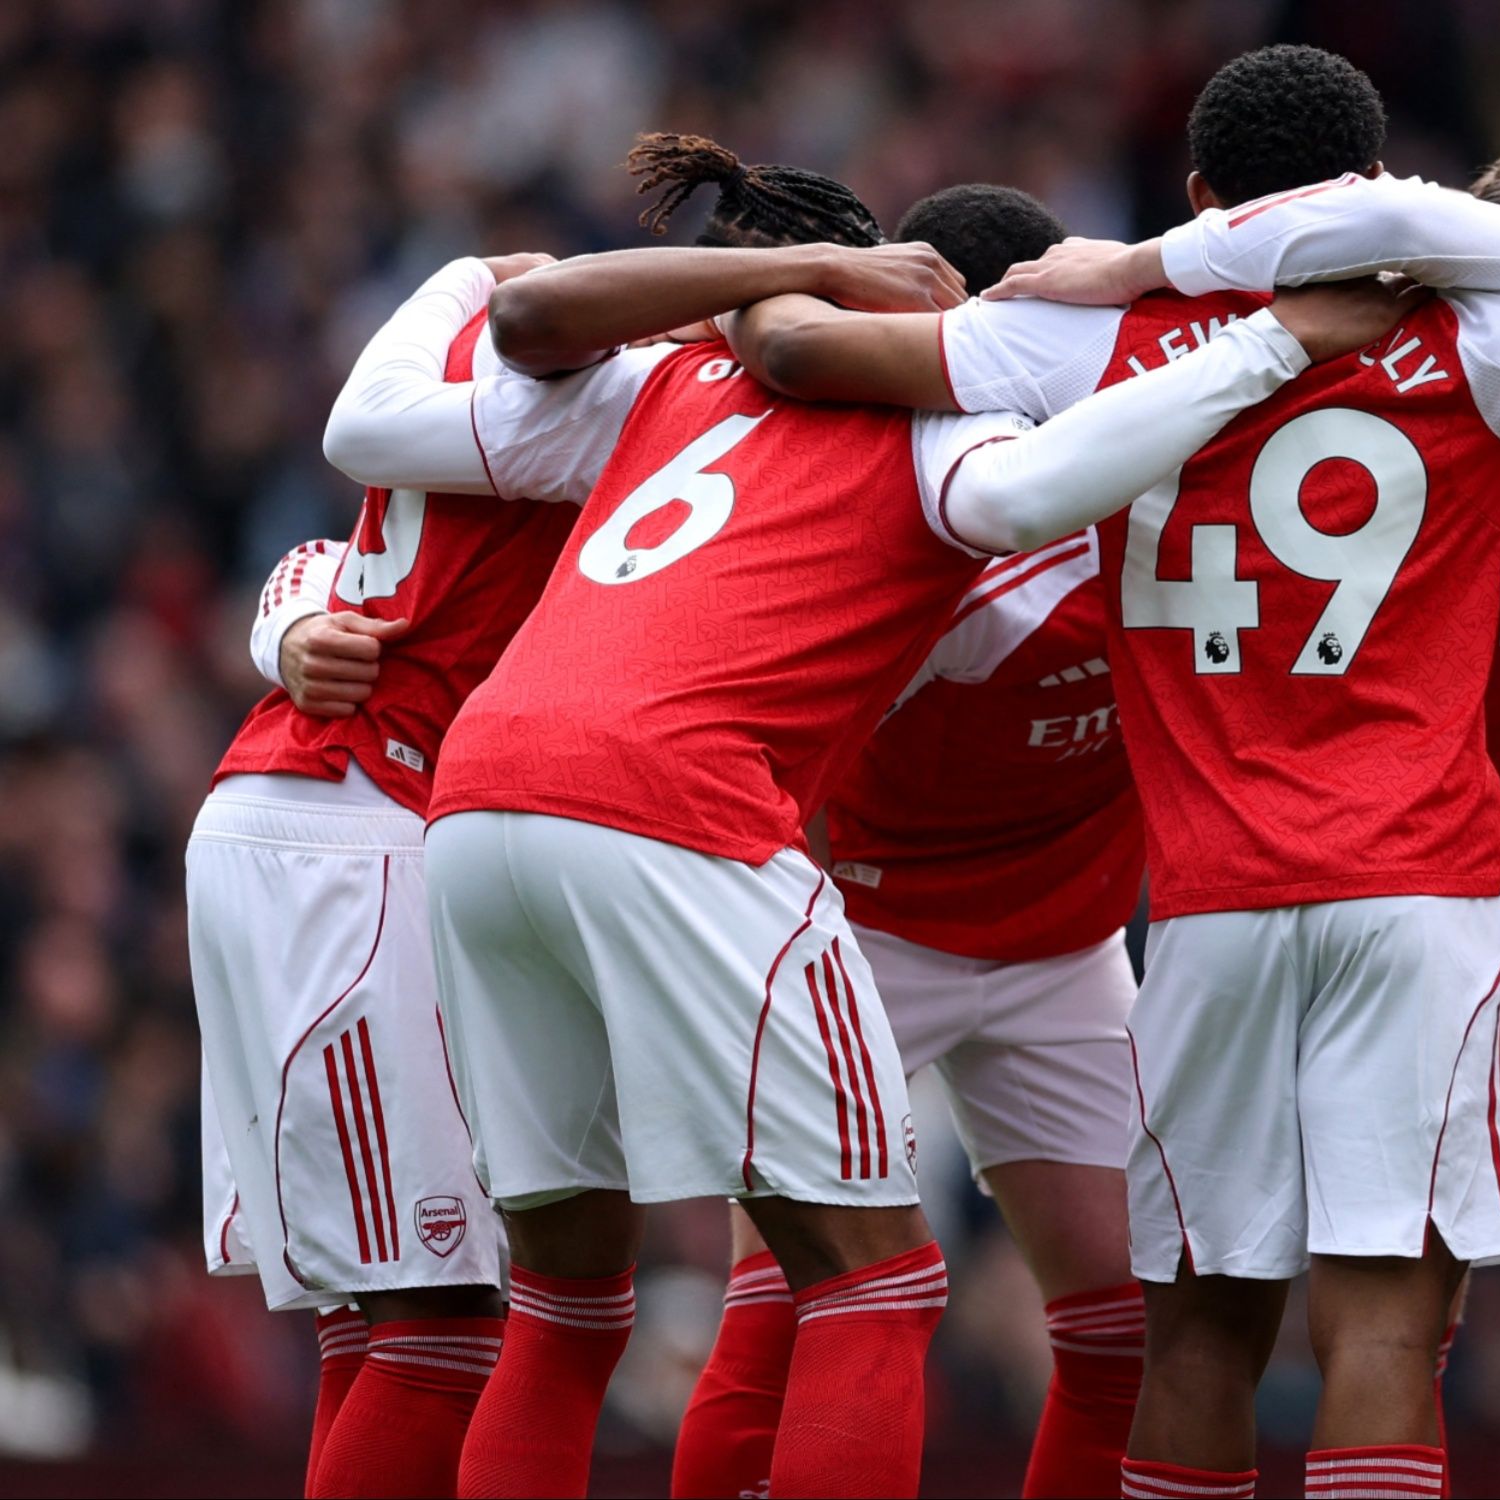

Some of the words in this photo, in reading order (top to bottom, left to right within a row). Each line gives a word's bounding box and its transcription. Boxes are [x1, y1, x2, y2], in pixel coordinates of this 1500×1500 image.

[577, 408, 775, 585] 6
[1120, 407, 1429, 676] 49
[421, 1205, 461, 1218] Arsenal
